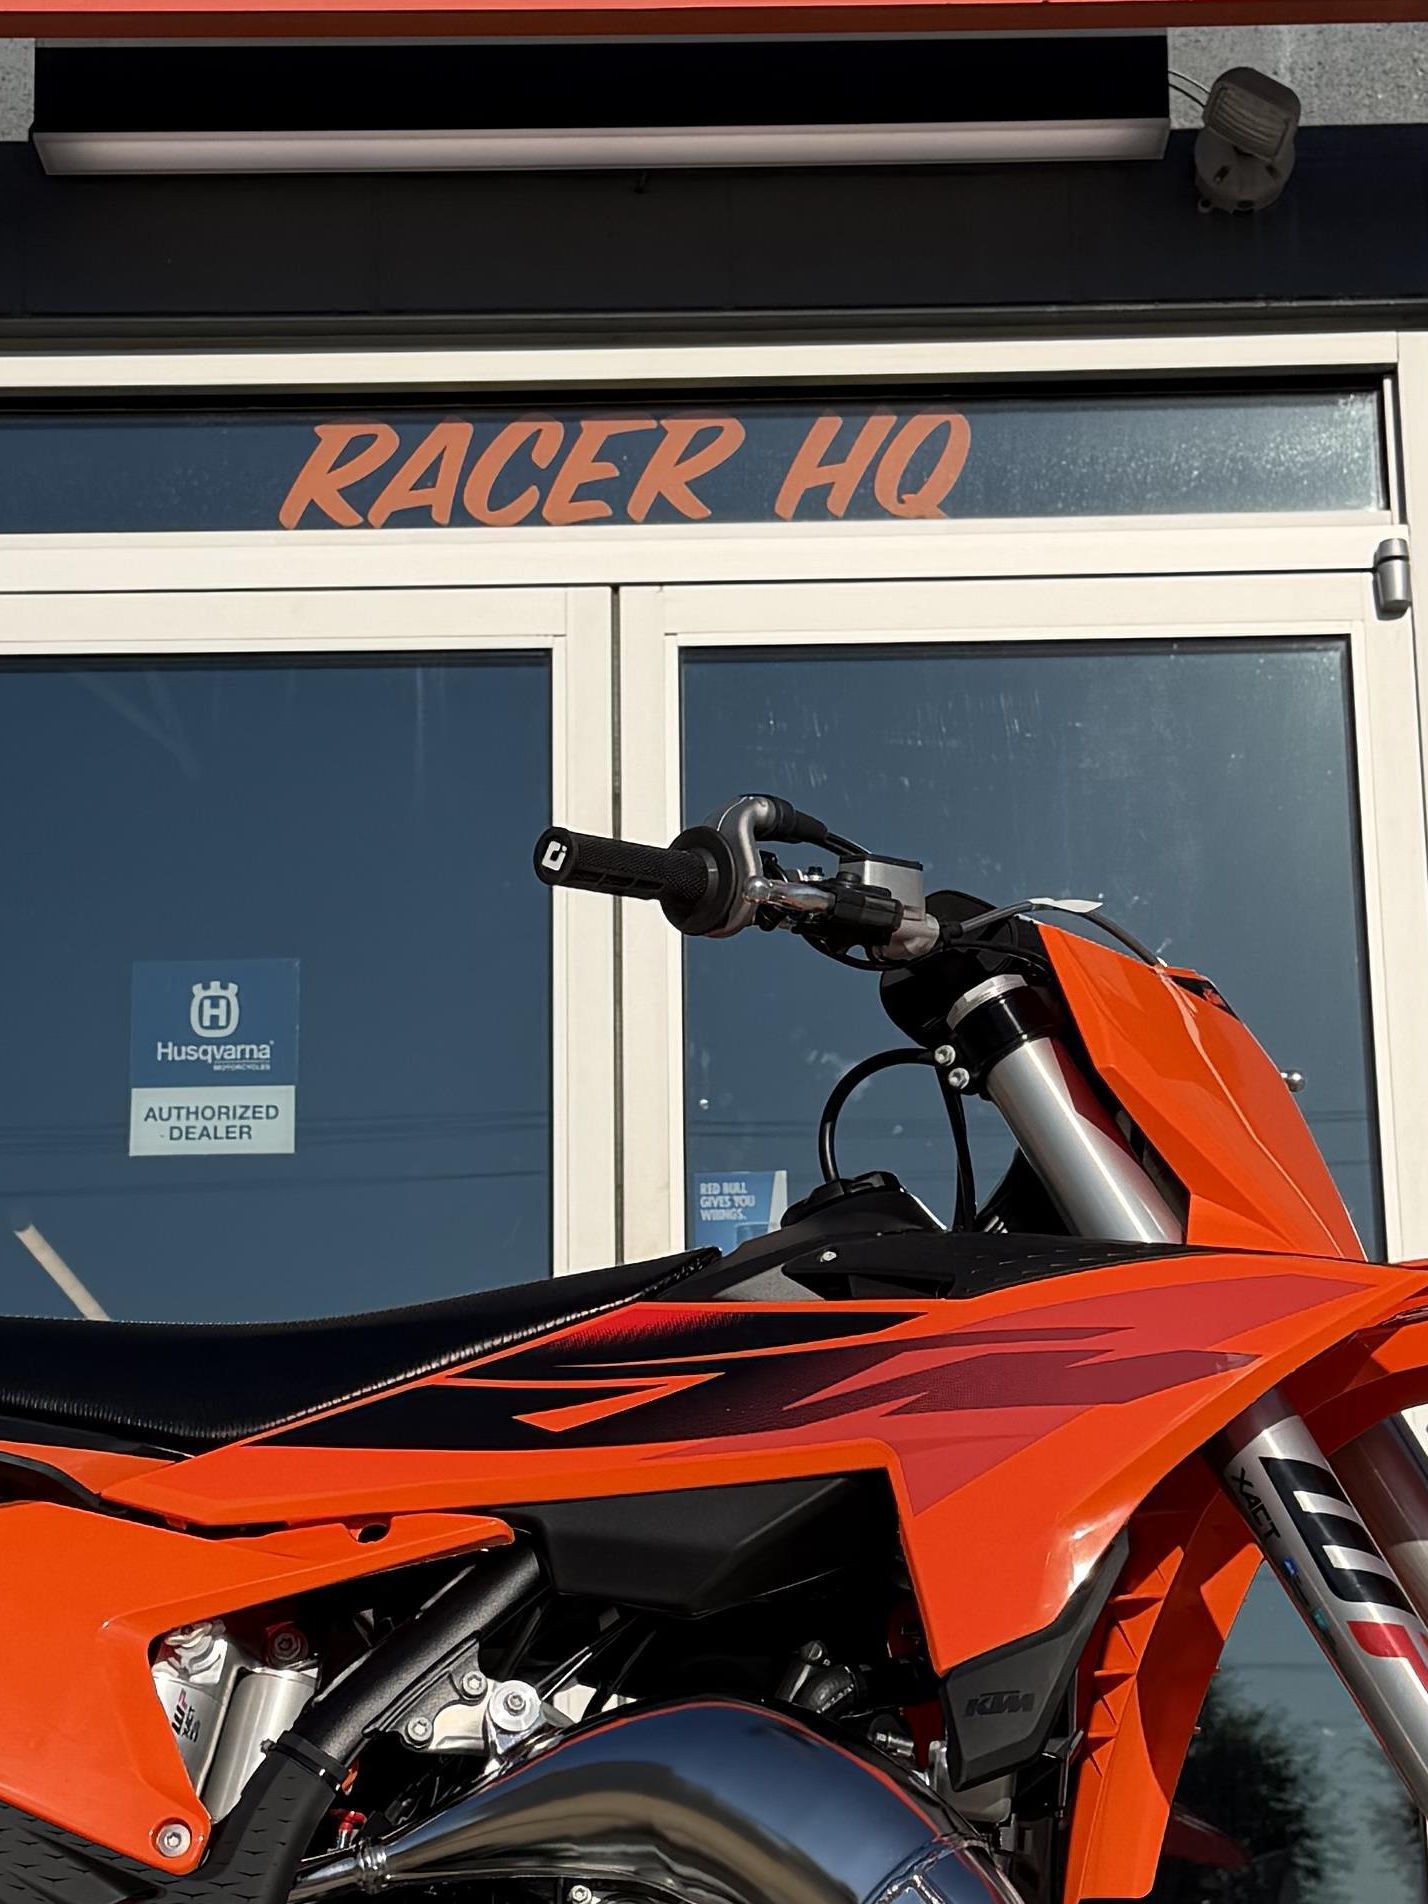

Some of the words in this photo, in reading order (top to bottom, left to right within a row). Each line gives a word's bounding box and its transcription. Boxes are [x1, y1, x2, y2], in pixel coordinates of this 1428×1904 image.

[278, 414, 746, 530] RACER
[774, 412, 972, 522] HQ
[156, 1041, 271, 1064] Husqvarna
[143, 1104, 280, 1123] AUTHORIZED
[169, 1124, 252, 1142] DEALER
[700, 1183, 721, 1195] RED
[723, 1182, 748, 1195] BULL
[700, 1196, 732, 1208] GIVES
[734, 1195, 756, 1208] YOU
[1230, 1466, 1282, 1540] XACT
[963, 1689, 1035, 1717] KTM
